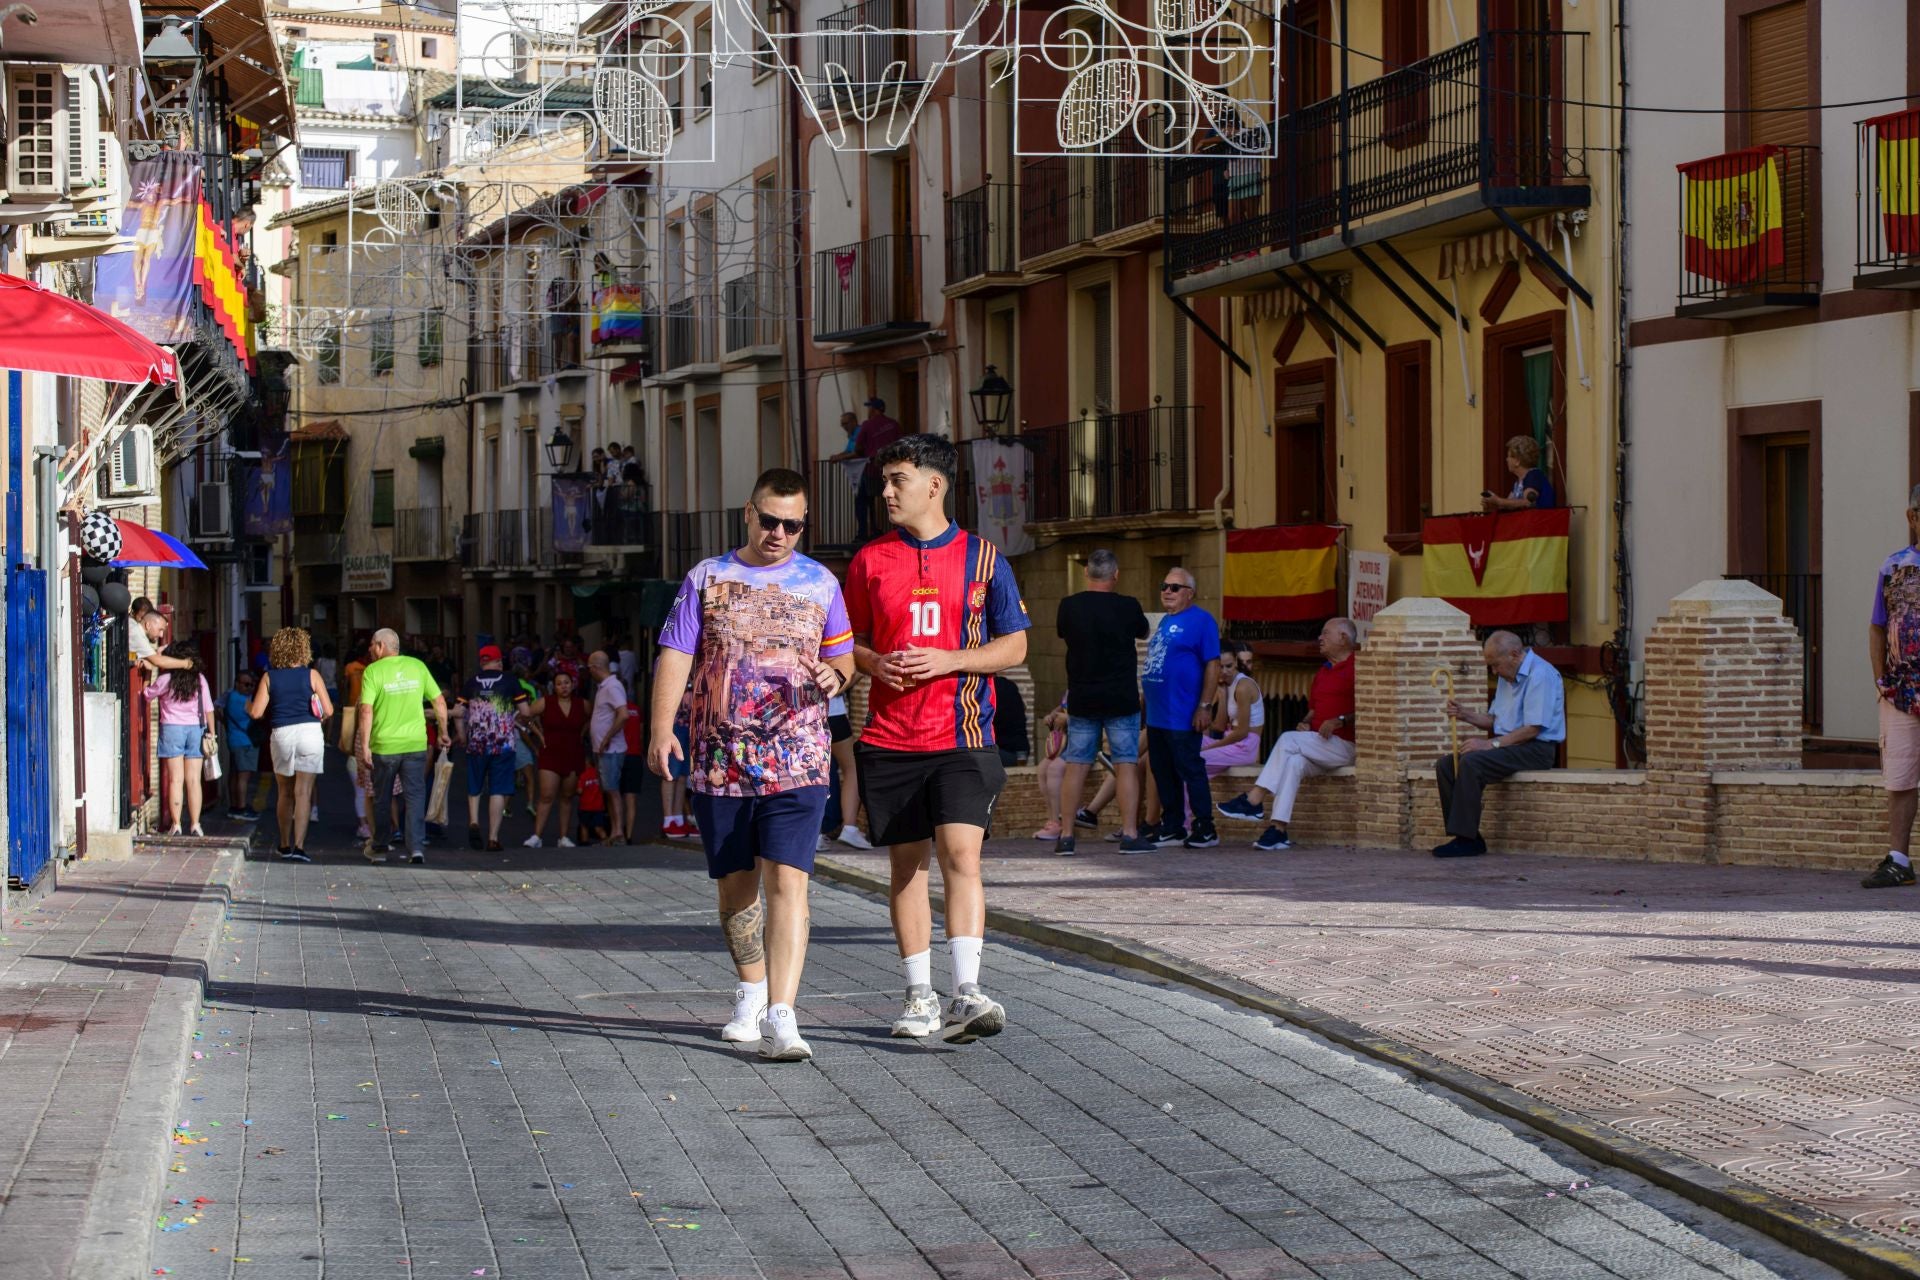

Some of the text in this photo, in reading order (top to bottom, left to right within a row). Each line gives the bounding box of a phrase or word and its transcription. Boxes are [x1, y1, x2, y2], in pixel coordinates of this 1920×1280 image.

[1359, 560, 1381, 576] PUNTO DE
[912, 588, 939, 596] adidas
[909, 601, 941, 637] 10
